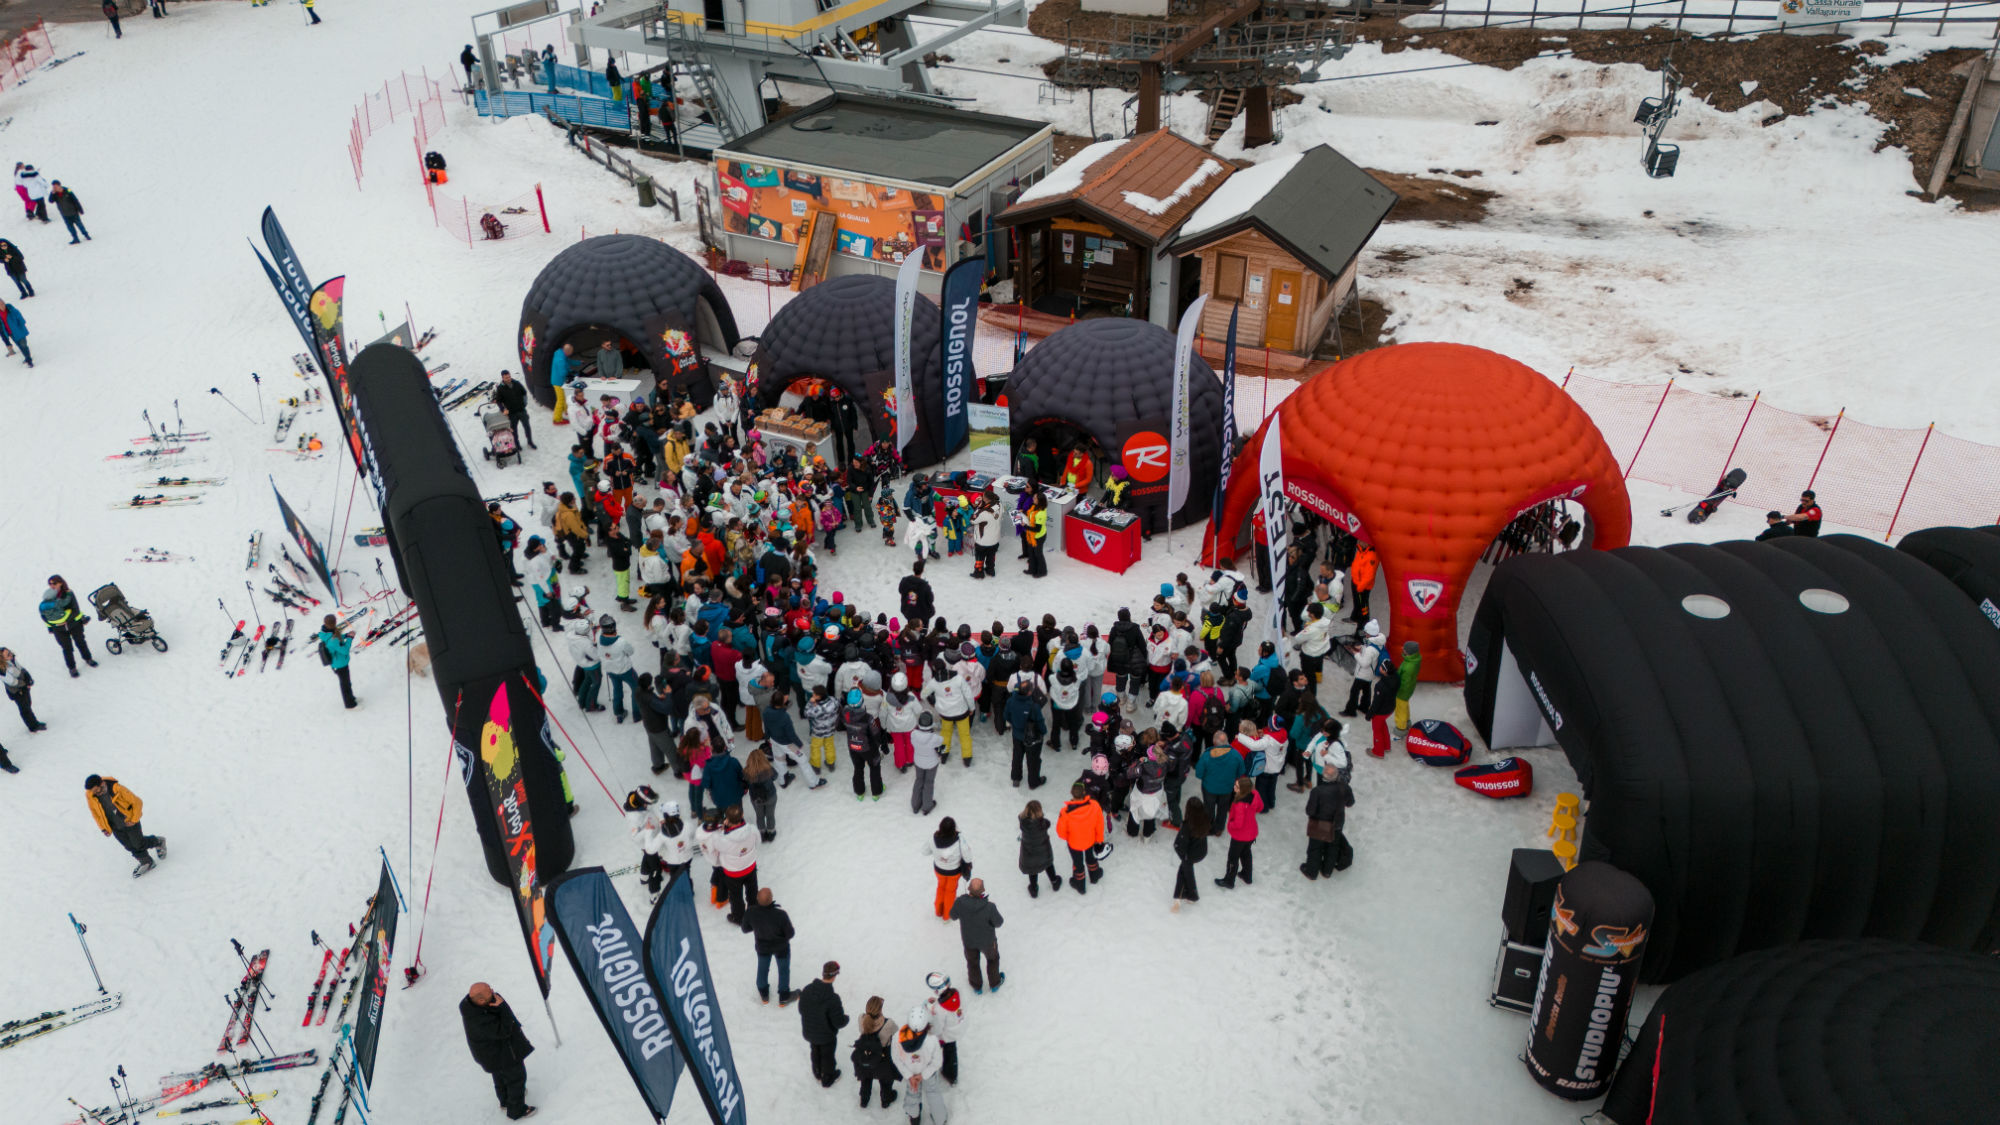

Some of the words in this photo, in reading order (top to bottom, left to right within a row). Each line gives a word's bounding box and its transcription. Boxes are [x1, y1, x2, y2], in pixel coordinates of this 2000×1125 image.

[1806, 7, 1851, 16] Vallagarina
[946, 296, 970, 418] ROSSIGNOL
[1287, 481, 1346, 525] ROSSIGNOL
[1472, 779, 1520, 790] ROSSIGNOL
[503, 789, 523, 835] COLOR
[586, 912, 673, 1061] ROSSIGNOL
[670, 936, 739, 1124] ROSSIGNOL
[1555, 1077, 1601, 1090] RADIO
